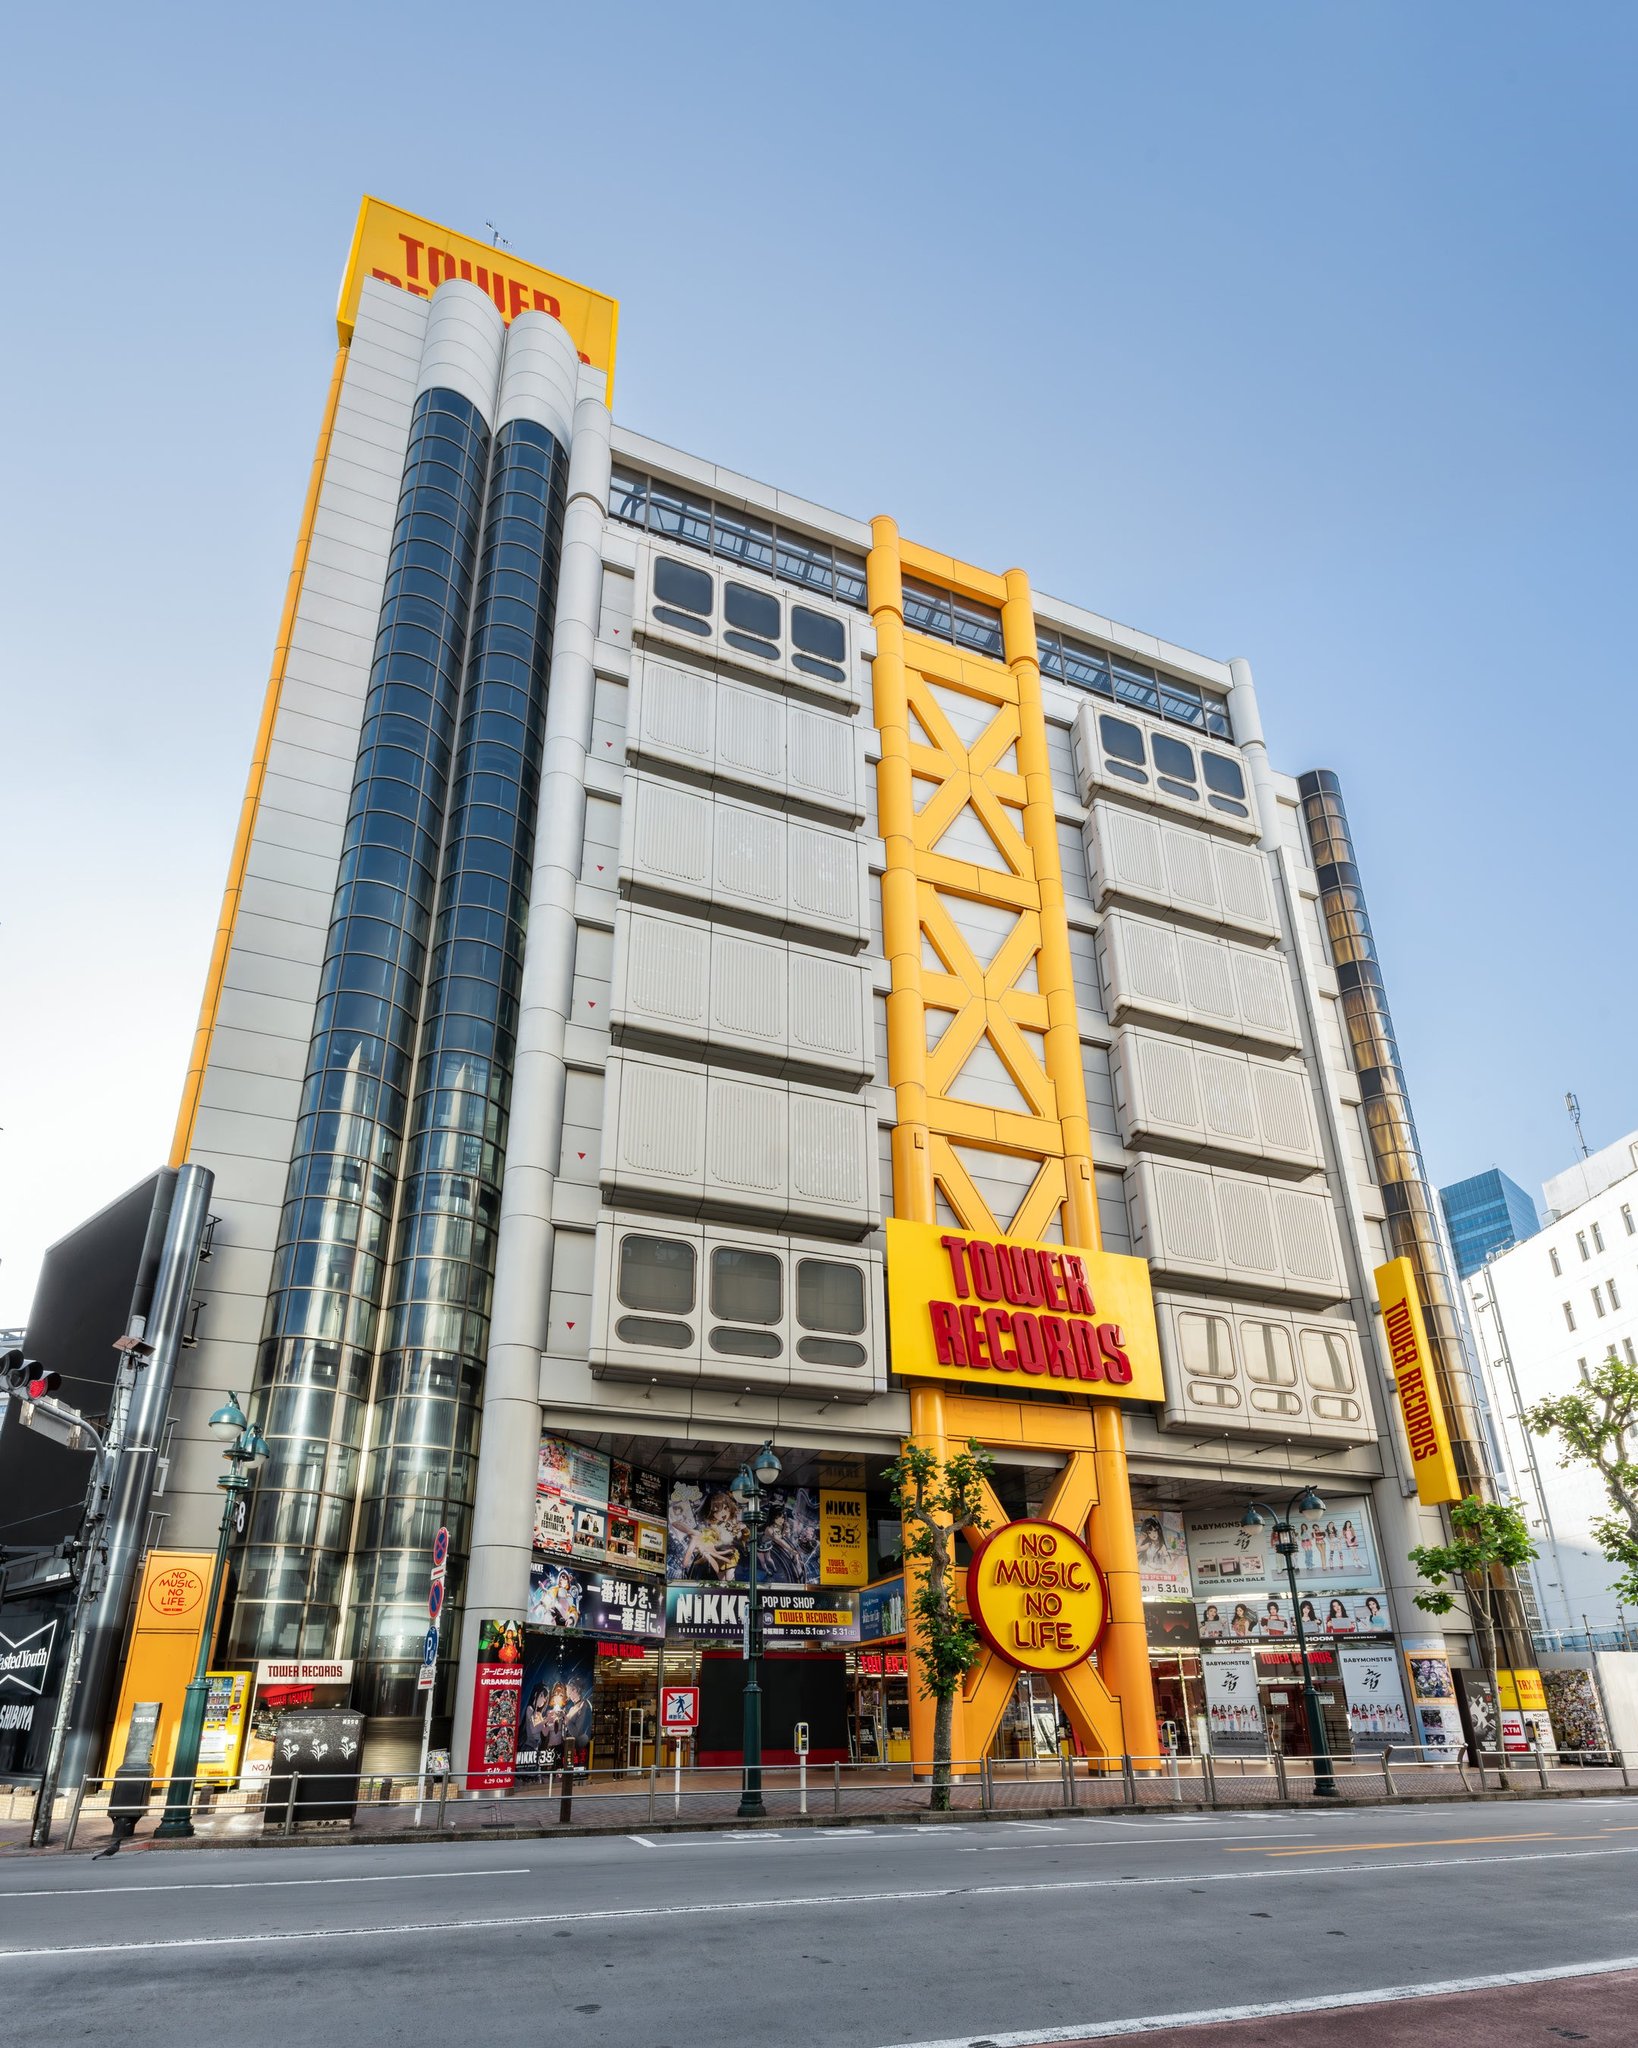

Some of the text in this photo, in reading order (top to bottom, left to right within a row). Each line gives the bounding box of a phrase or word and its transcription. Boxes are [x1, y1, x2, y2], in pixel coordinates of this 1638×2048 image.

[940, 1235, 1096, 1315] TOWER
[928, 1300, 1133, 1385] RECORDS
[1384, 1297, 1438, 1462] TOWER RECORDS
[826, 1500, 861, 1517] NIKKE
[1019, 1533, 1057, 1557] NO
[828, 1559, 845, 1567] TOWER
[171, 1571, 187, 1579] NO
[826, 1567, 849, 1575] RECORDS
[994, 1559, 1091, 1592] MUSIC,
[159, 1579, 196, 1589] MUSIC,
[160, 1597, 187, 1606] LIFE.
[587, 1579, 652, 1609] 一番推しを、
[761, 1595, 815, 1609] POP UP SHOP
[1024, 1592, 1062, 1617] NO
[779, 1611, 838, 1623] TOWER RECORDS
[1012, 1620, 1080, 1651] LIFE.
[1291, 1652, 1333, 1664] REORDS
[268, 1665, 343, 1677] TOWER RECORDS
[0, 1705, 34, 1731] SHIBUYA
[1503, 1726, 1521, 1734] ATM
